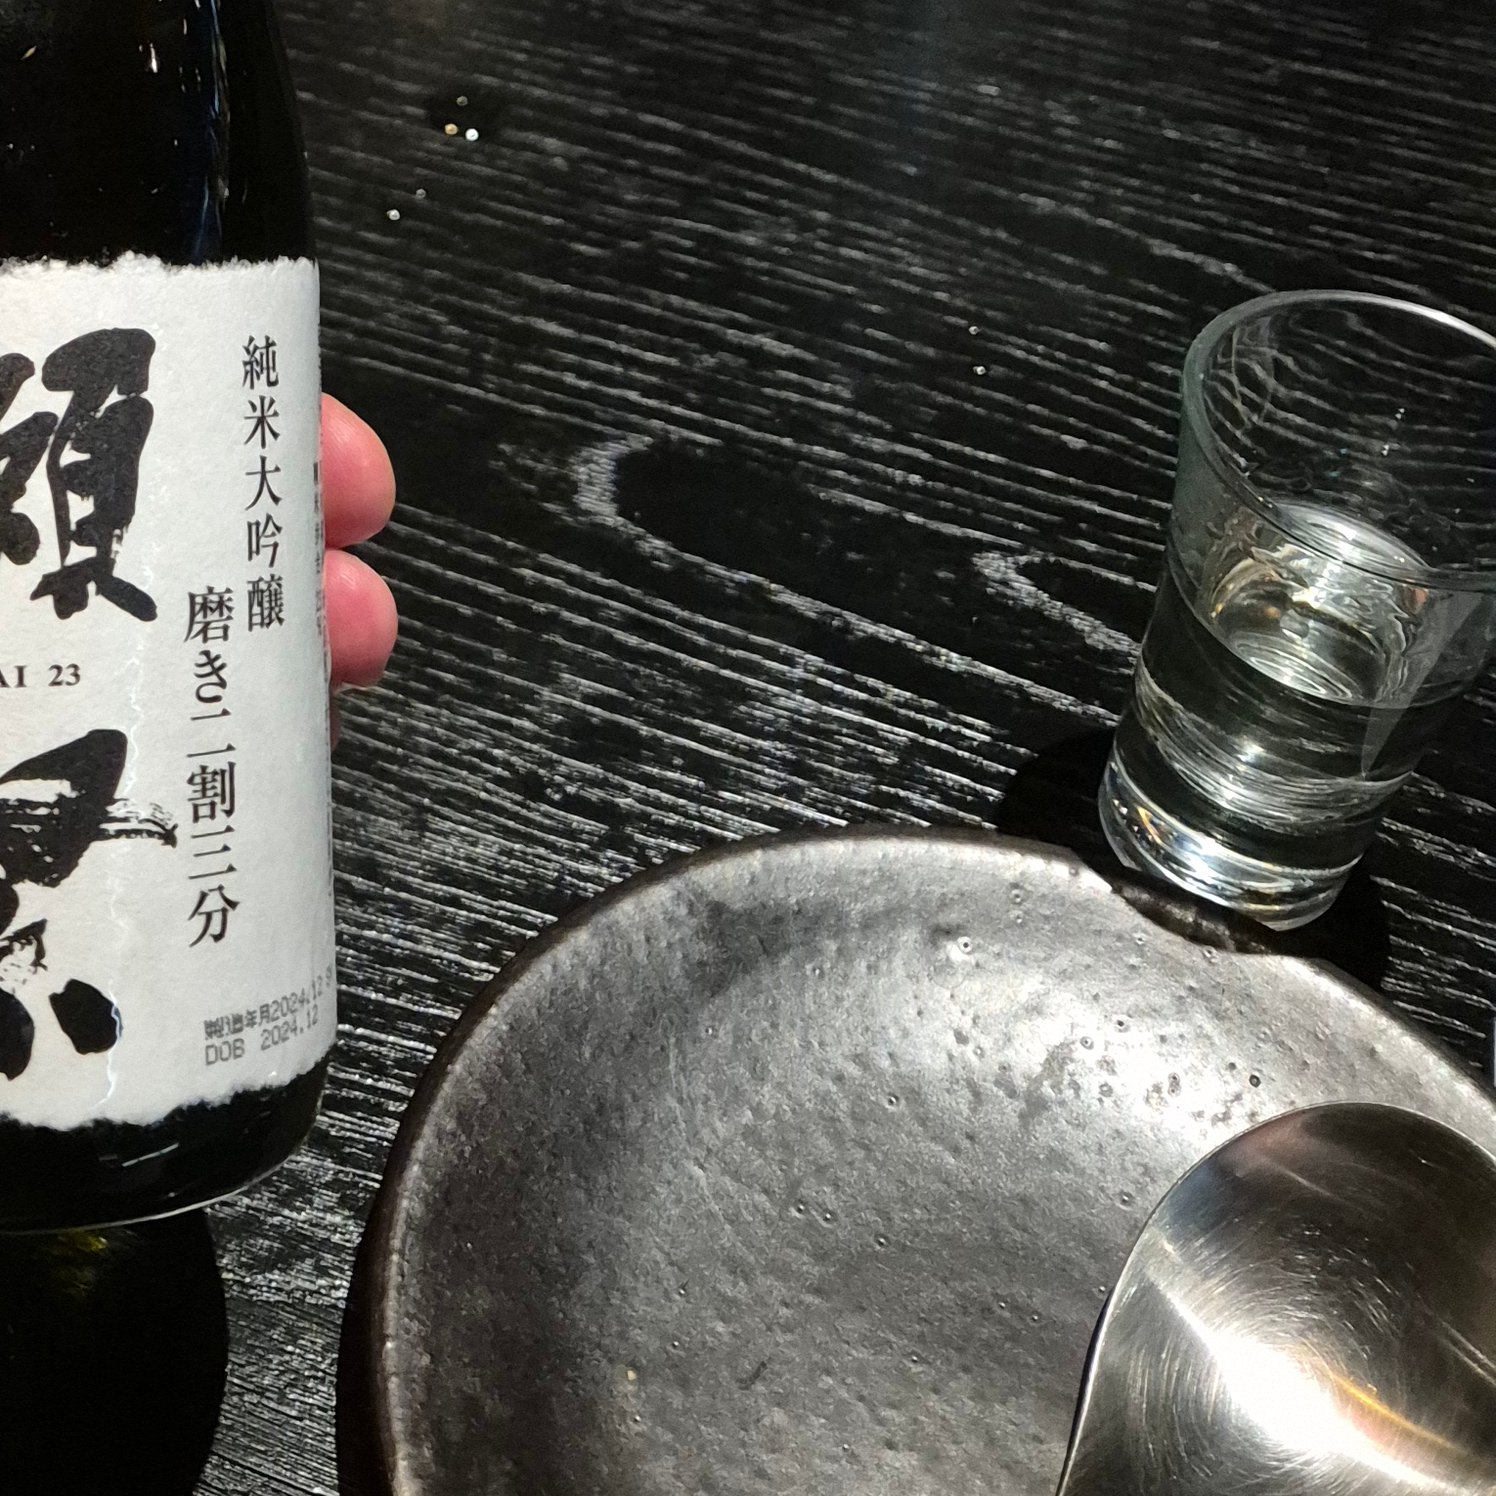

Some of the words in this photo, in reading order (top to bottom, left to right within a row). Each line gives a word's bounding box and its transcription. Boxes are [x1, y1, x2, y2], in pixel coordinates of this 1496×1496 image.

[241, 334, 286, 633] 純米大吟醸
[47, 662, 82, 687] 23
[182, 585, 242, 949] 磨き二割三分
[205, 1037, 246, 1066] DOB
[260, 1003, 320, 1052] 2024.12
